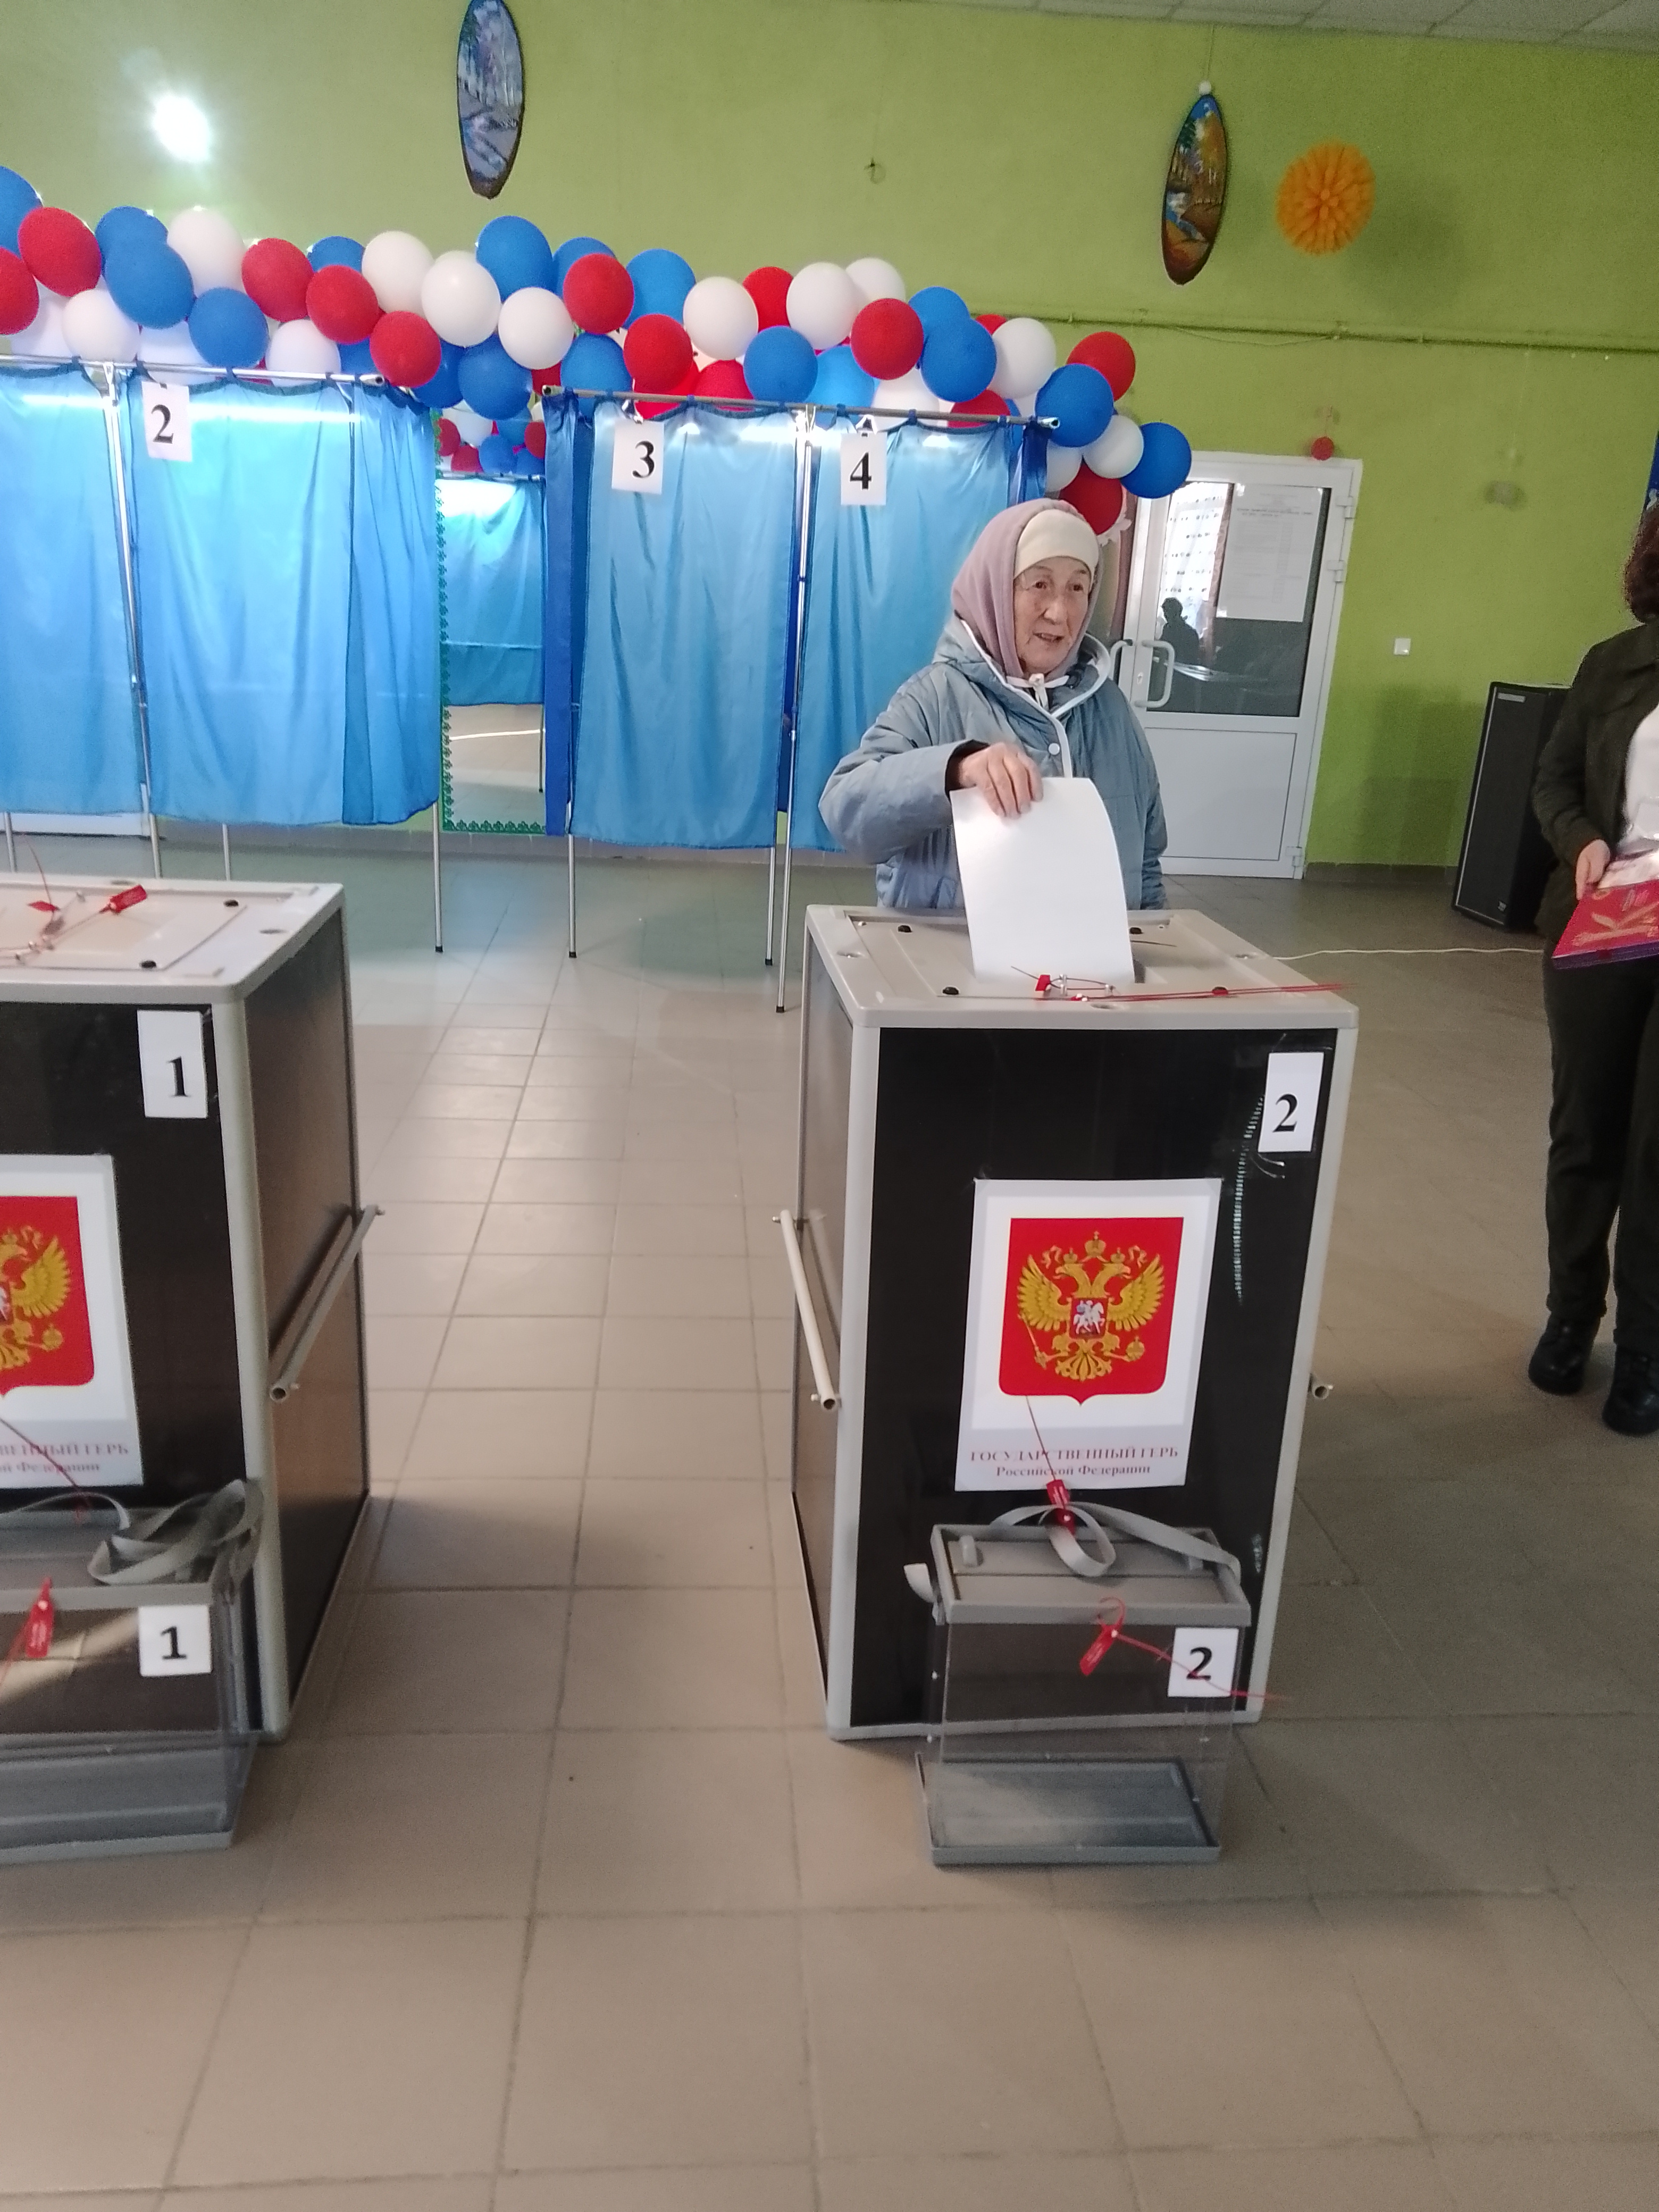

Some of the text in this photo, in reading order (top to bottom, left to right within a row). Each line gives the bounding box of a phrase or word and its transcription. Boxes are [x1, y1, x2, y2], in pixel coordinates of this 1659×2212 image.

[152, 404, 174, 443] 2
[632, 441, 655, 479] 3
[849, 452, 872, 490] 4
[167, 1056, 189, 1097] 1
[1272, 1093, 1298, 1133] 2
[161, 1626, 187, 1660] 1
[1186, 1646, 1213, 1681] 2
